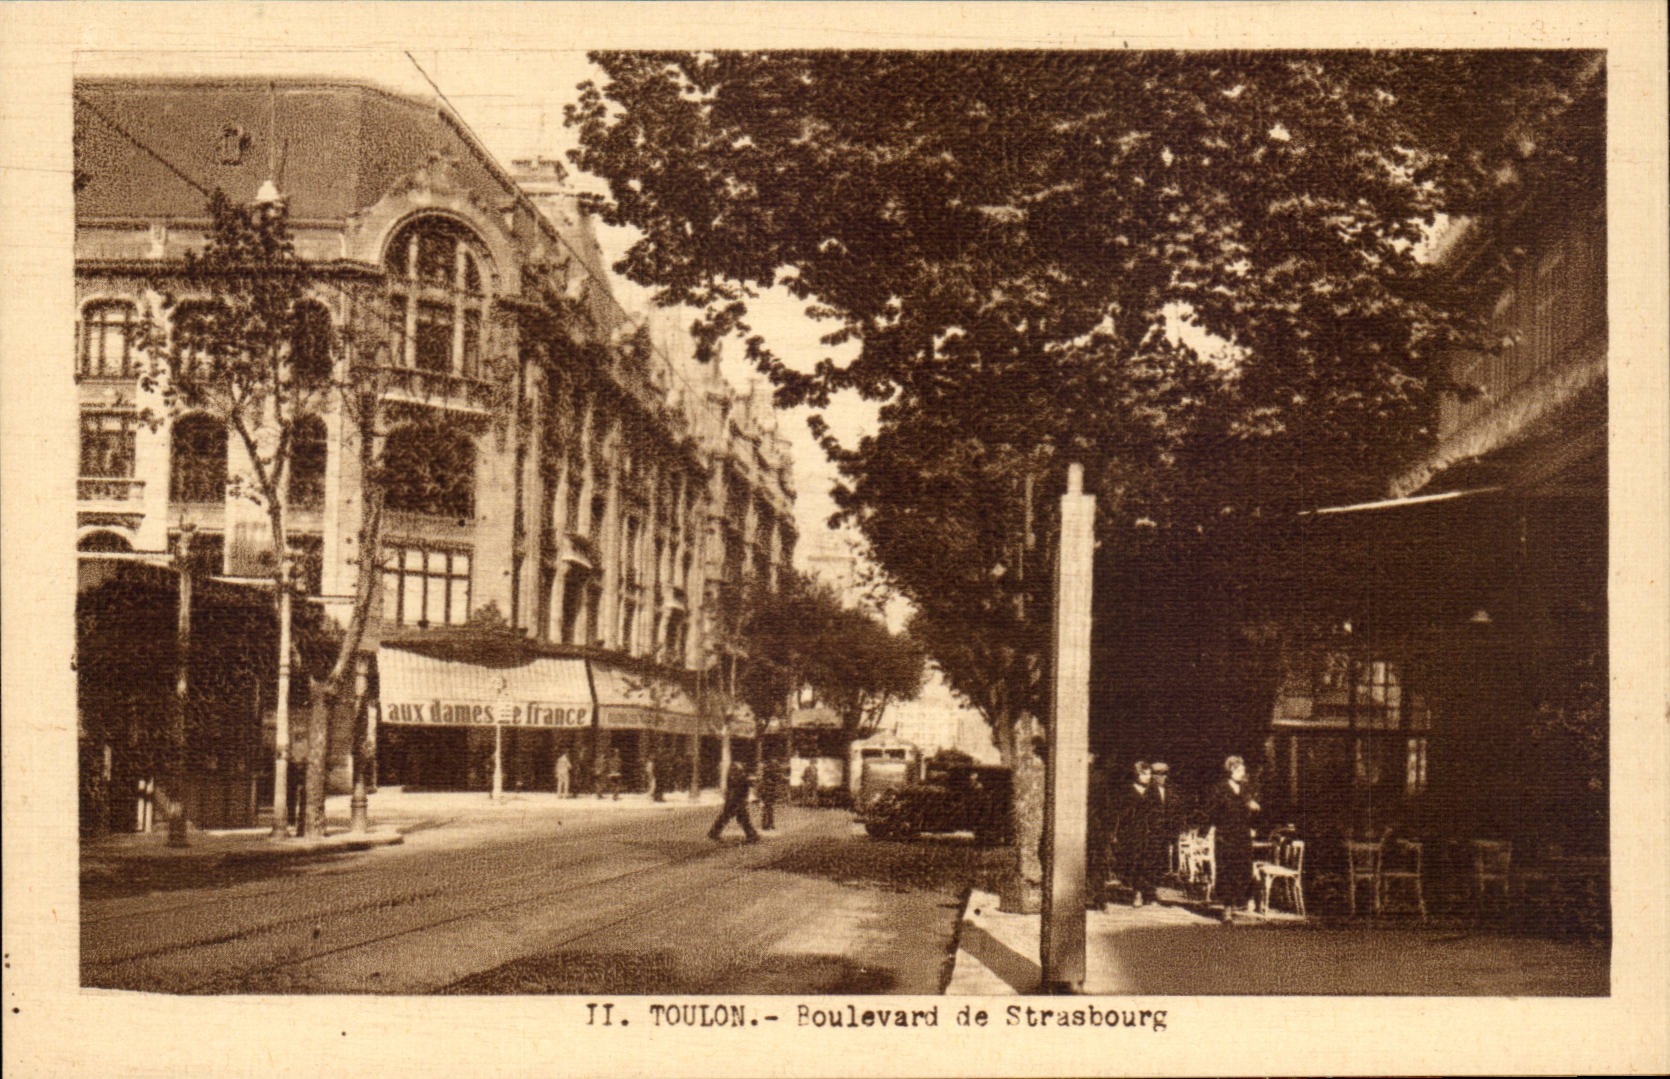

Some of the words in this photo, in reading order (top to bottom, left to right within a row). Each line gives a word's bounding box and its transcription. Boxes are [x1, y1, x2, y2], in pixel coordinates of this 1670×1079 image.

[387, 702, 425, 722] aux
[429, 699, 495, 725] dames
[526, 701, 587, 726] france
